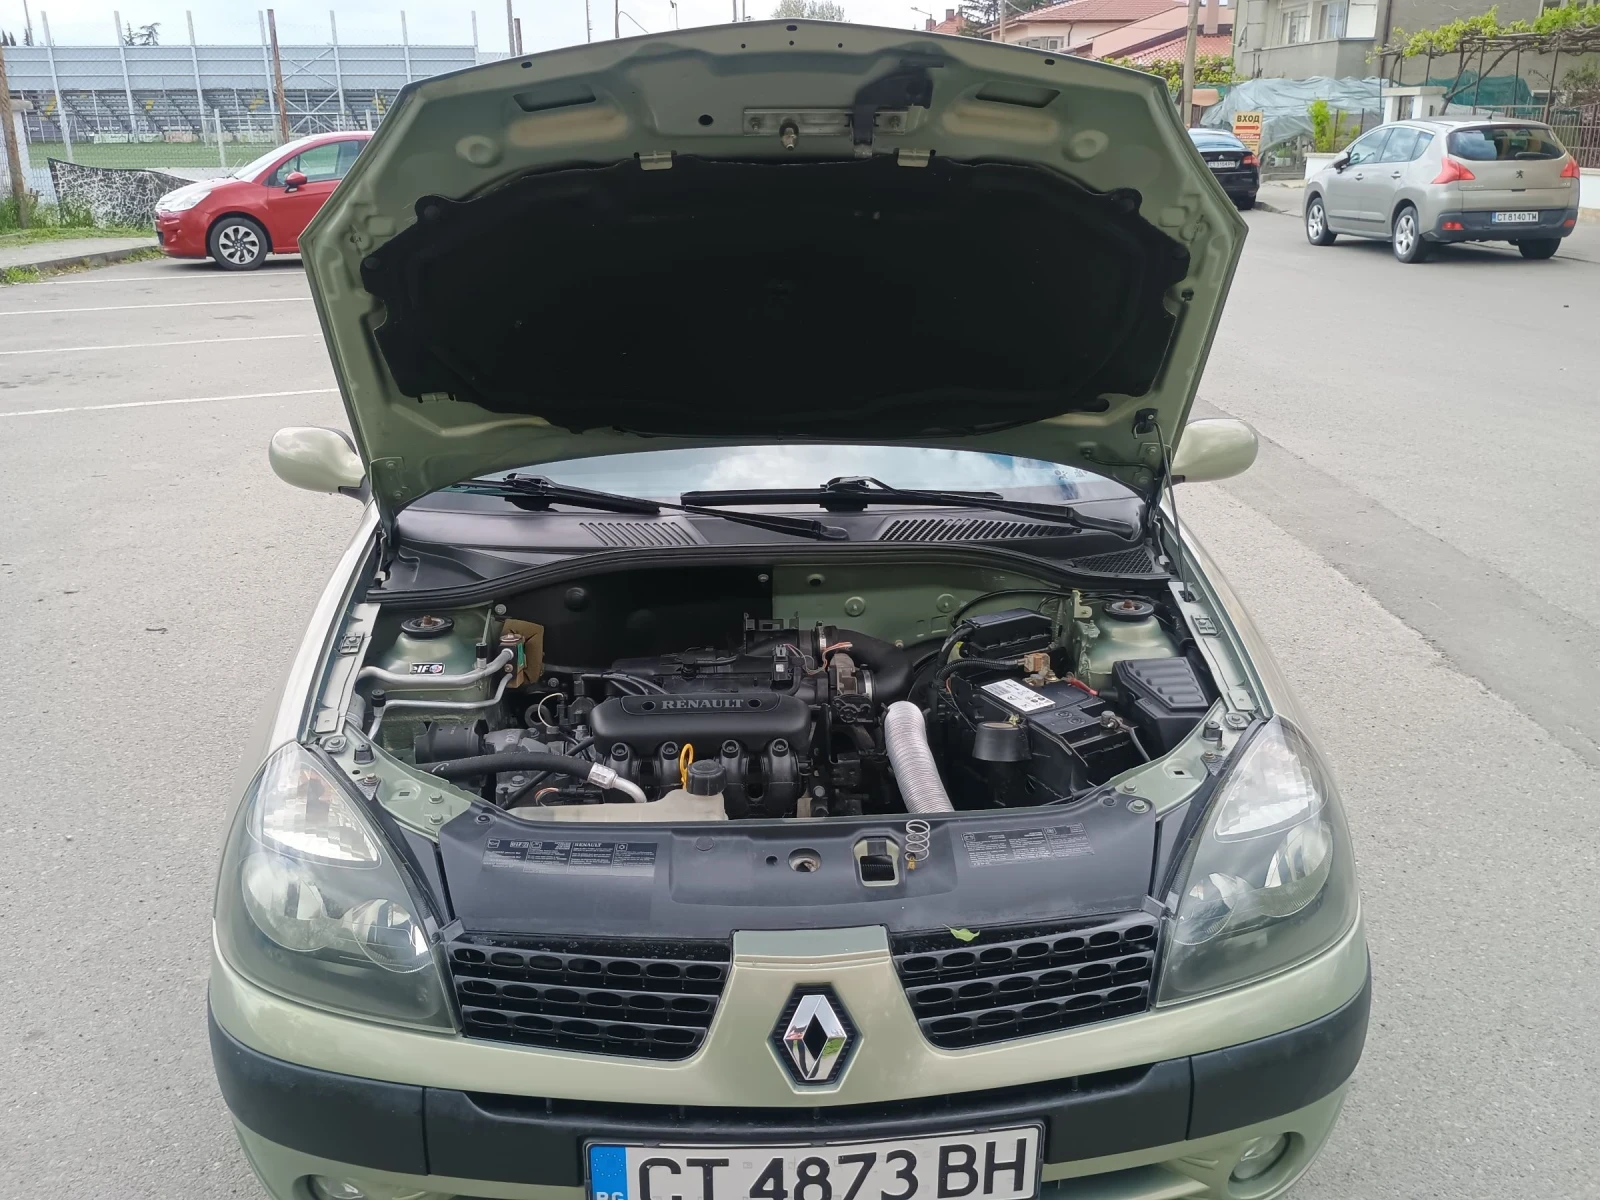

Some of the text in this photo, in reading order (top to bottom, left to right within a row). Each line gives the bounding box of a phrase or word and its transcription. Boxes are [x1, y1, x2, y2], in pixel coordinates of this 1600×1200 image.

[1236, 115, 1260, 123] ВХОД
[1497, 213, 1507, 221] CT
[1508, 213, 1526, 221] 8140
[661, 699, 744, 709] RENAULT
[638, 1137, 1028, 1200] CT 4873 BH
